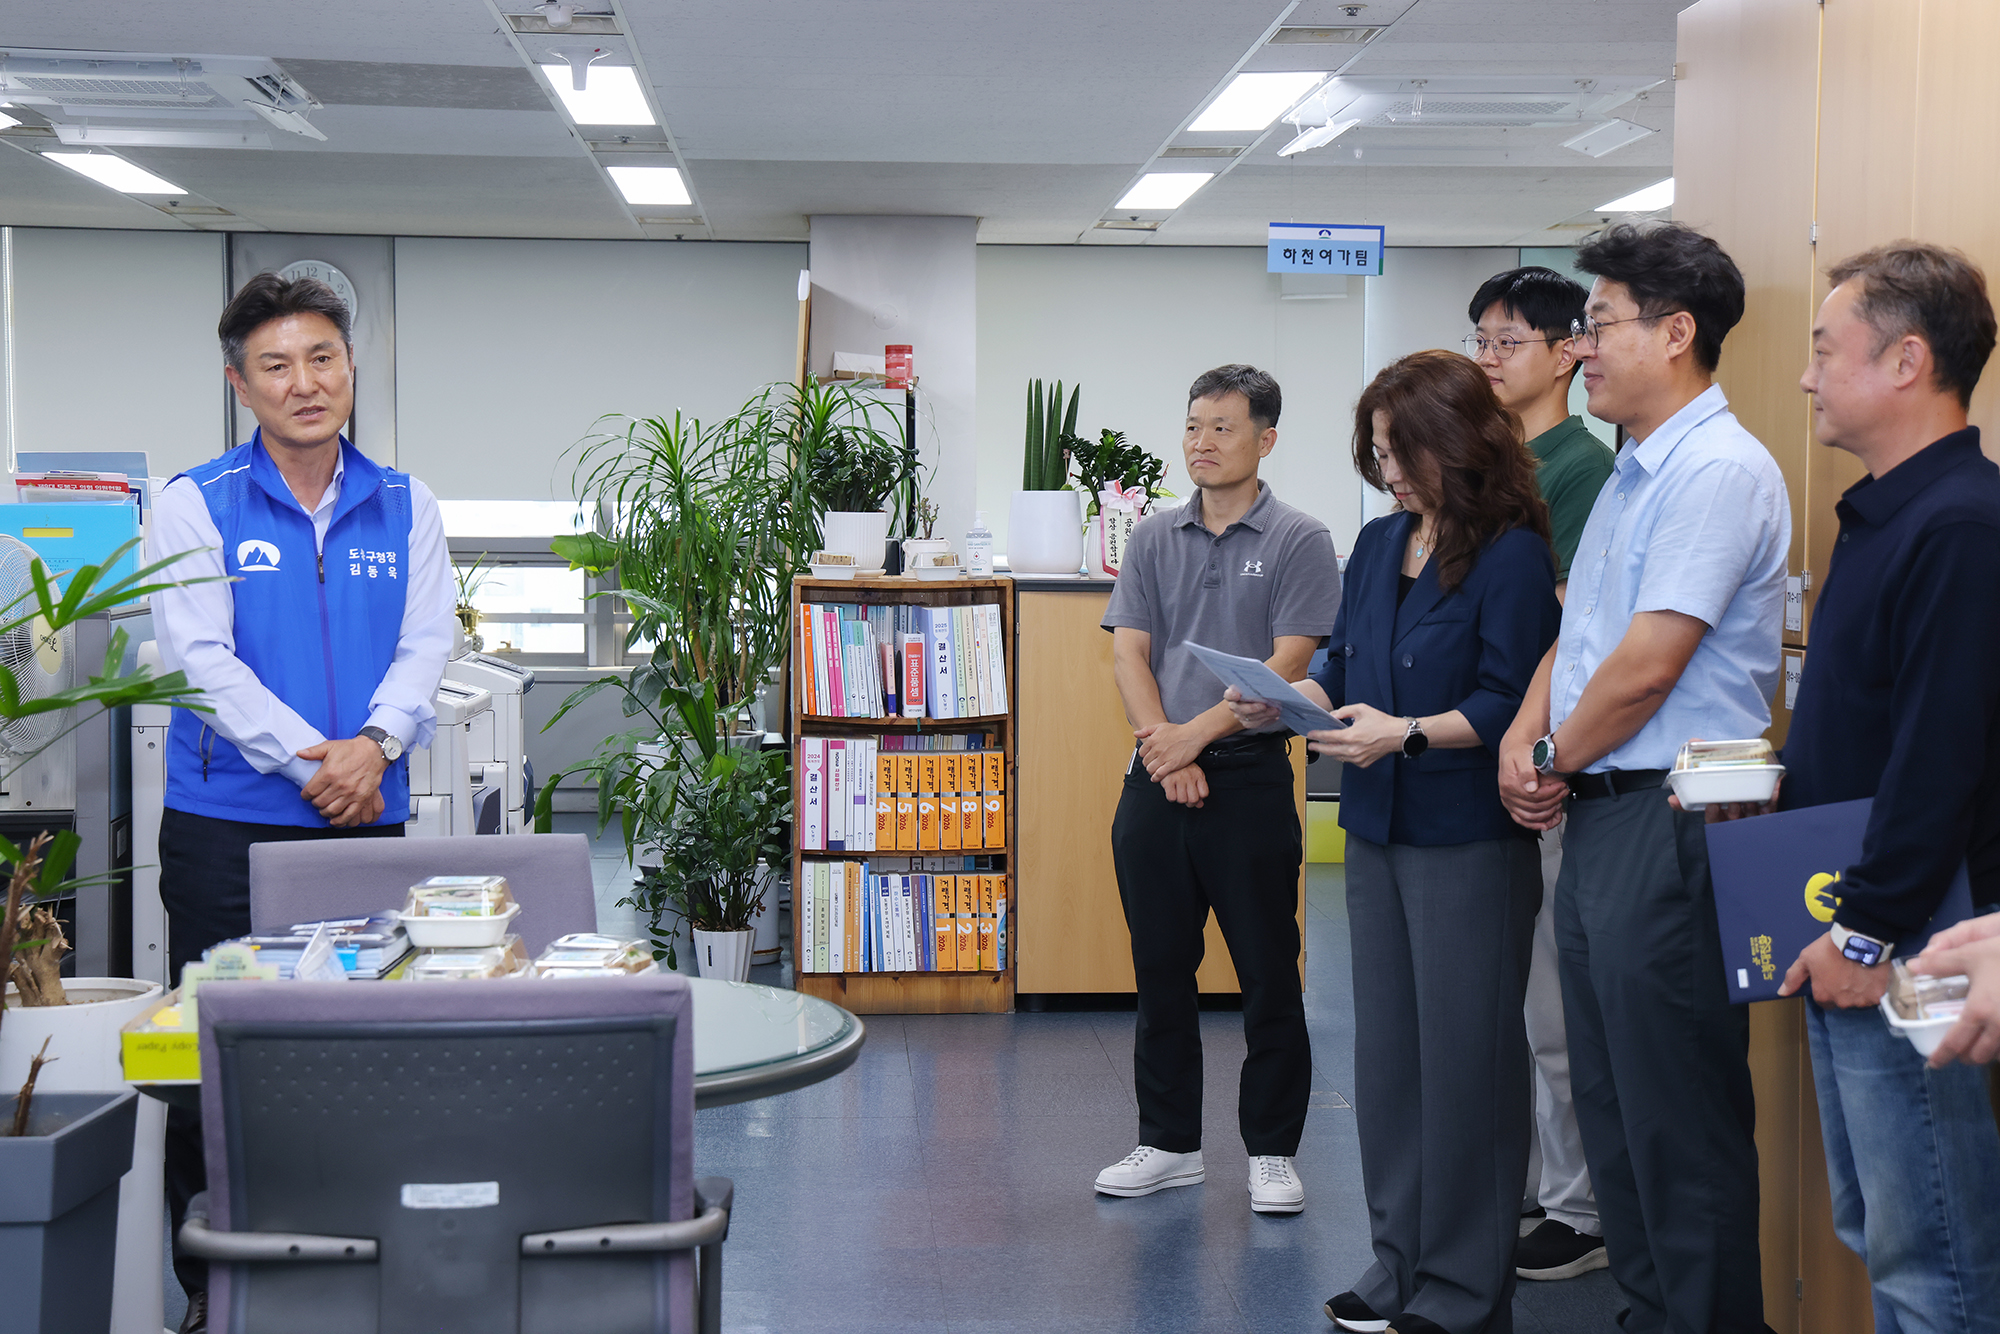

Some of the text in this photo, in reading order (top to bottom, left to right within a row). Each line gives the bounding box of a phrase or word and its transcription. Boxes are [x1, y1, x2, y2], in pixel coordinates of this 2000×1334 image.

[1283, 248, 1368, 266] 하천여가팀
[306, 267, 318, 278] 12
[327, 272, 332, 282] 1
[337, 284, 344, 294] 2
[938, 642, 948, 674] 결산서
[910, 659, 920, 696] 표준품셈
[810, 774, 818, 806] 결산서
[877, 802, 891, 813] 4
[898, 802, 912, 813] 5
[919, 802, 934, 814] 6
[941, 802, 956, 814] 7
[962, 801, 977, 813] 8
[985, 800, 1000, 812] 9
[958, 923, 972, 934] 2
[980, 922, 993, 933] 3
[136, 1042, 168, 1053] Paper
